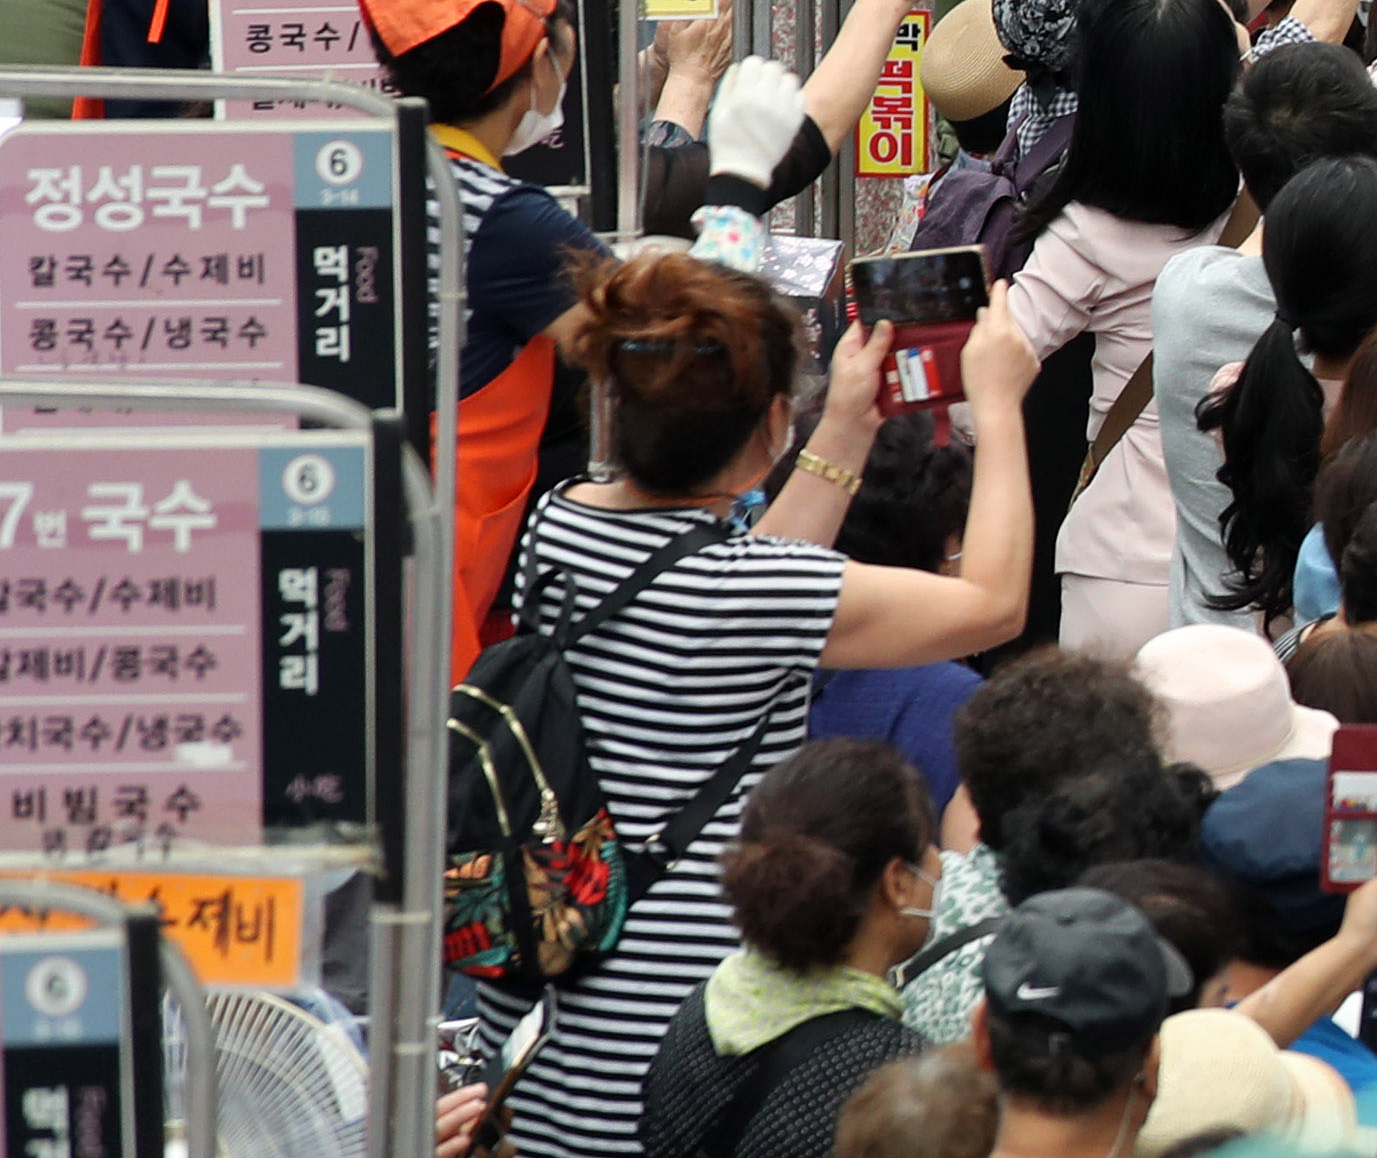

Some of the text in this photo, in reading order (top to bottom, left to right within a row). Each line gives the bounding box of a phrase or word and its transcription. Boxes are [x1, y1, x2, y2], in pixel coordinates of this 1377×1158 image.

[246, 21, 361, 53] 콩국수/
[329, 149, 347, 176] 6
[25, 164, 271, 231] 정성국수
[29, 253, 267, 289] 칼국수/수제비
[355, 246, 379, 303] Food
[312, 244, 351, 363] 먹거리
[30, 316, 269, 352] 콩국수/냉국수
[81, 478, 218, 554] 국수
[278, 566, 319, 697] 먹거리
[0, 713, 244, 753] 치국수/냉국수
